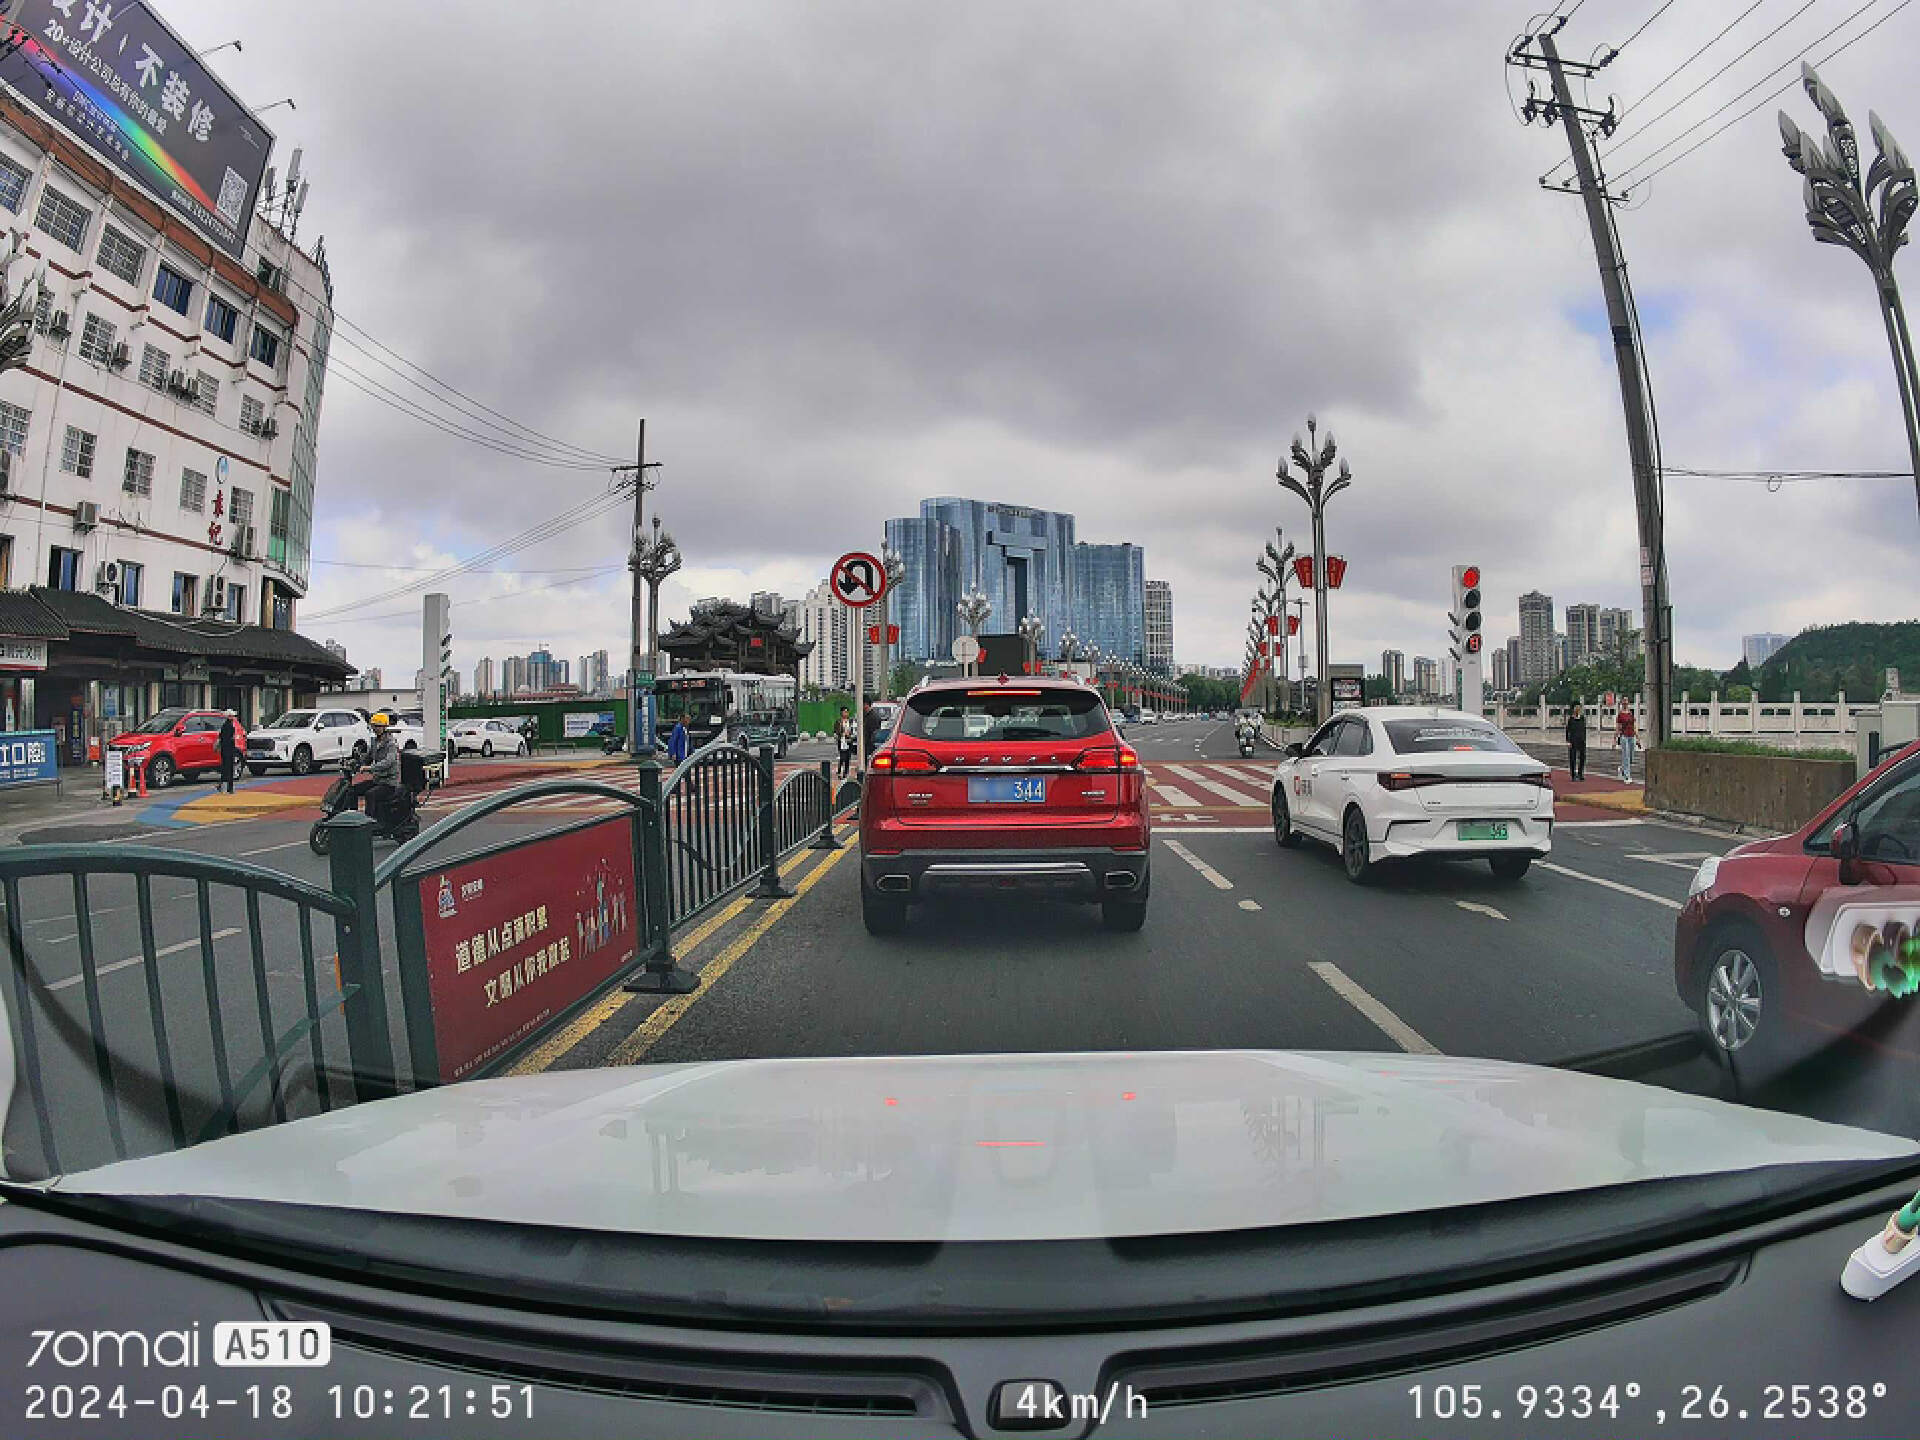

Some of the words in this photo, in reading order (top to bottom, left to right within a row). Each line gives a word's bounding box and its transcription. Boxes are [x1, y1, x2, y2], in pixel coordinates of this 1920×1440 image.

[455, 904, 548, 976] 道德从点滴积累
[483, 935, 571, 1008] 文明从你我做起
